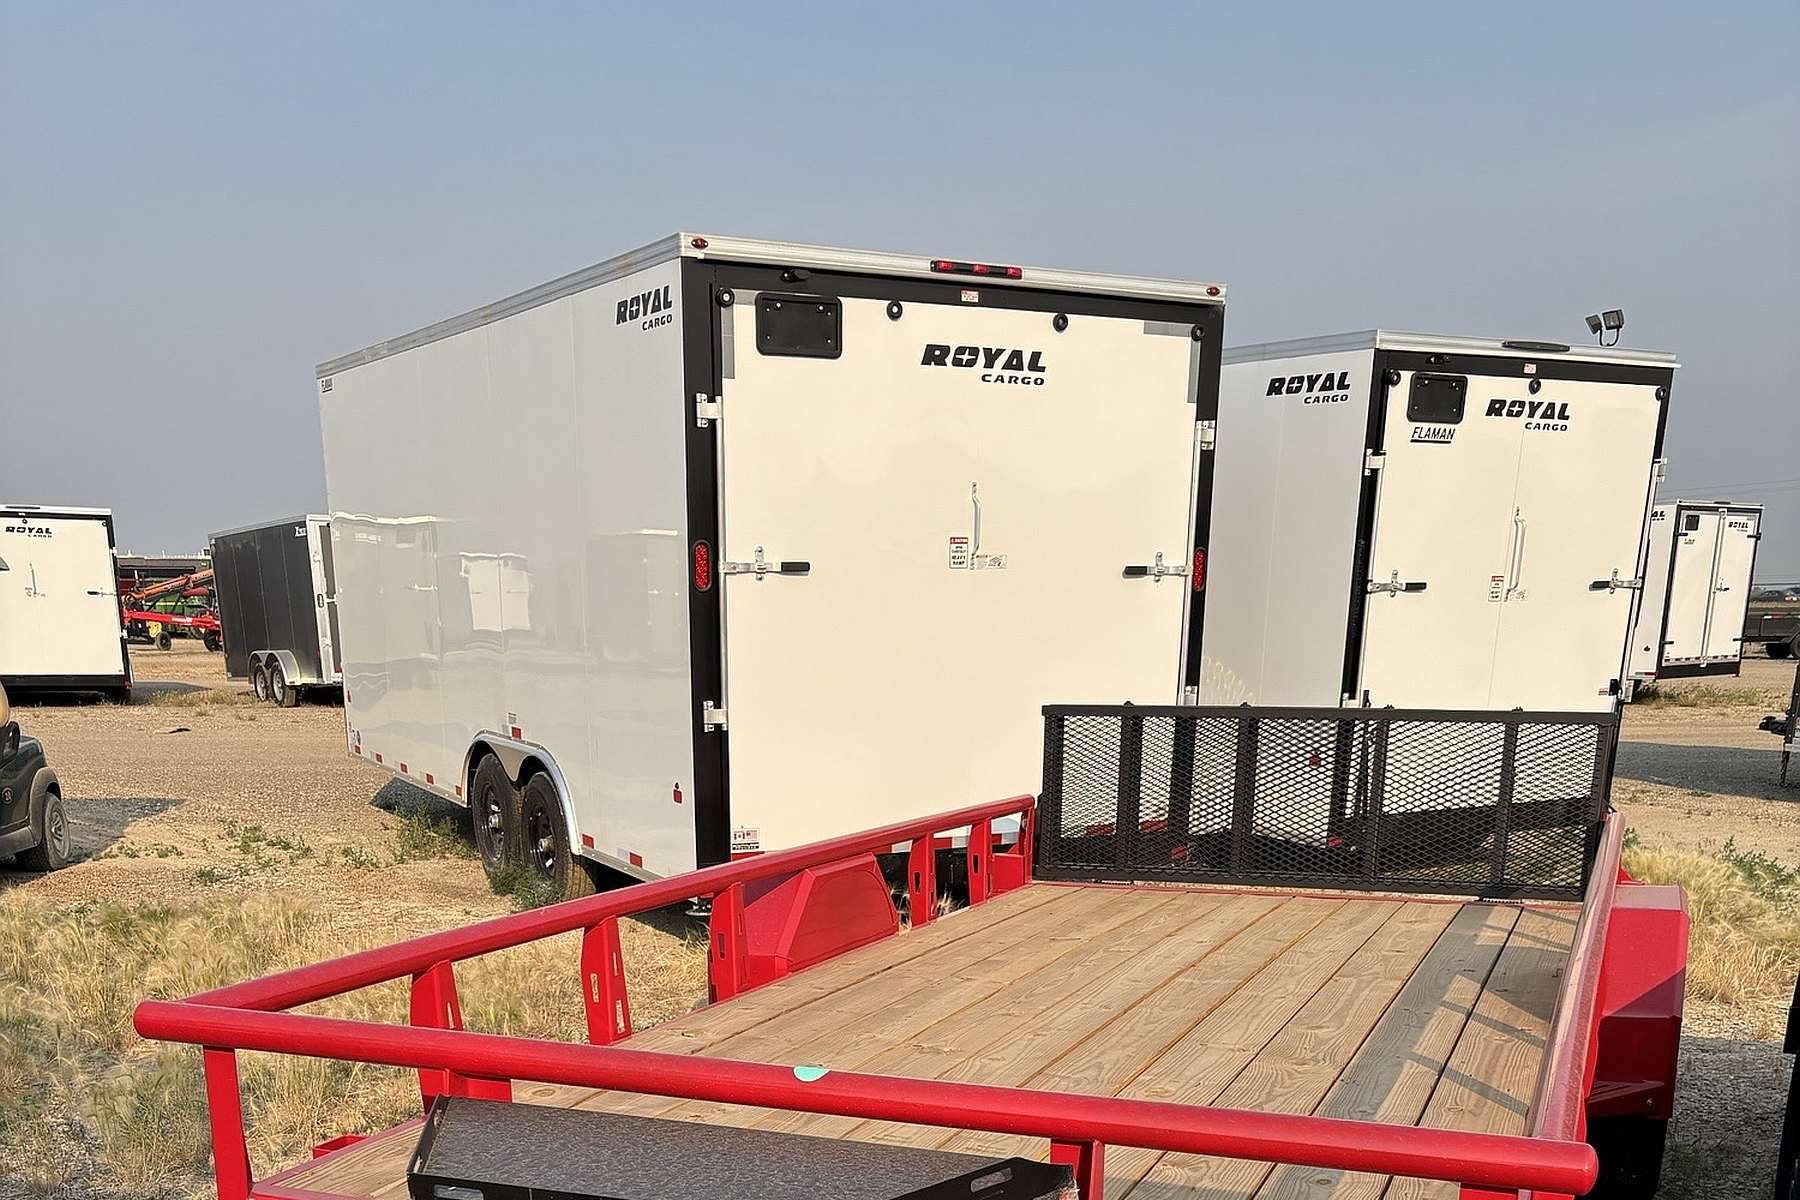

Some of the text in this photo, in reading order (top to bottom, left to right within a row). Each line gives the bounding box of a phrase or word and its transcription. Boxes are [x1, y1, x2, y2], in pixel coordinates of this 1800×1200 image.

[616, 285, 673, 325] ROYAL
[642, 314, 673, 331] CARGO
[920, 344, 1047, 373] ROYAL
[981, 373, 1045, 385] CARGO
[1265, 371, 1351, 396] ROYAL
[1303, 394, 1349, 404] CARGO
[1485, 399, 1570, 420] ROYAL
[1411, 427, 1456, 441] FLAMAN
[1524, 422, 1568, 432] CARGO
[5, 526, 53, 534] ROYAL
